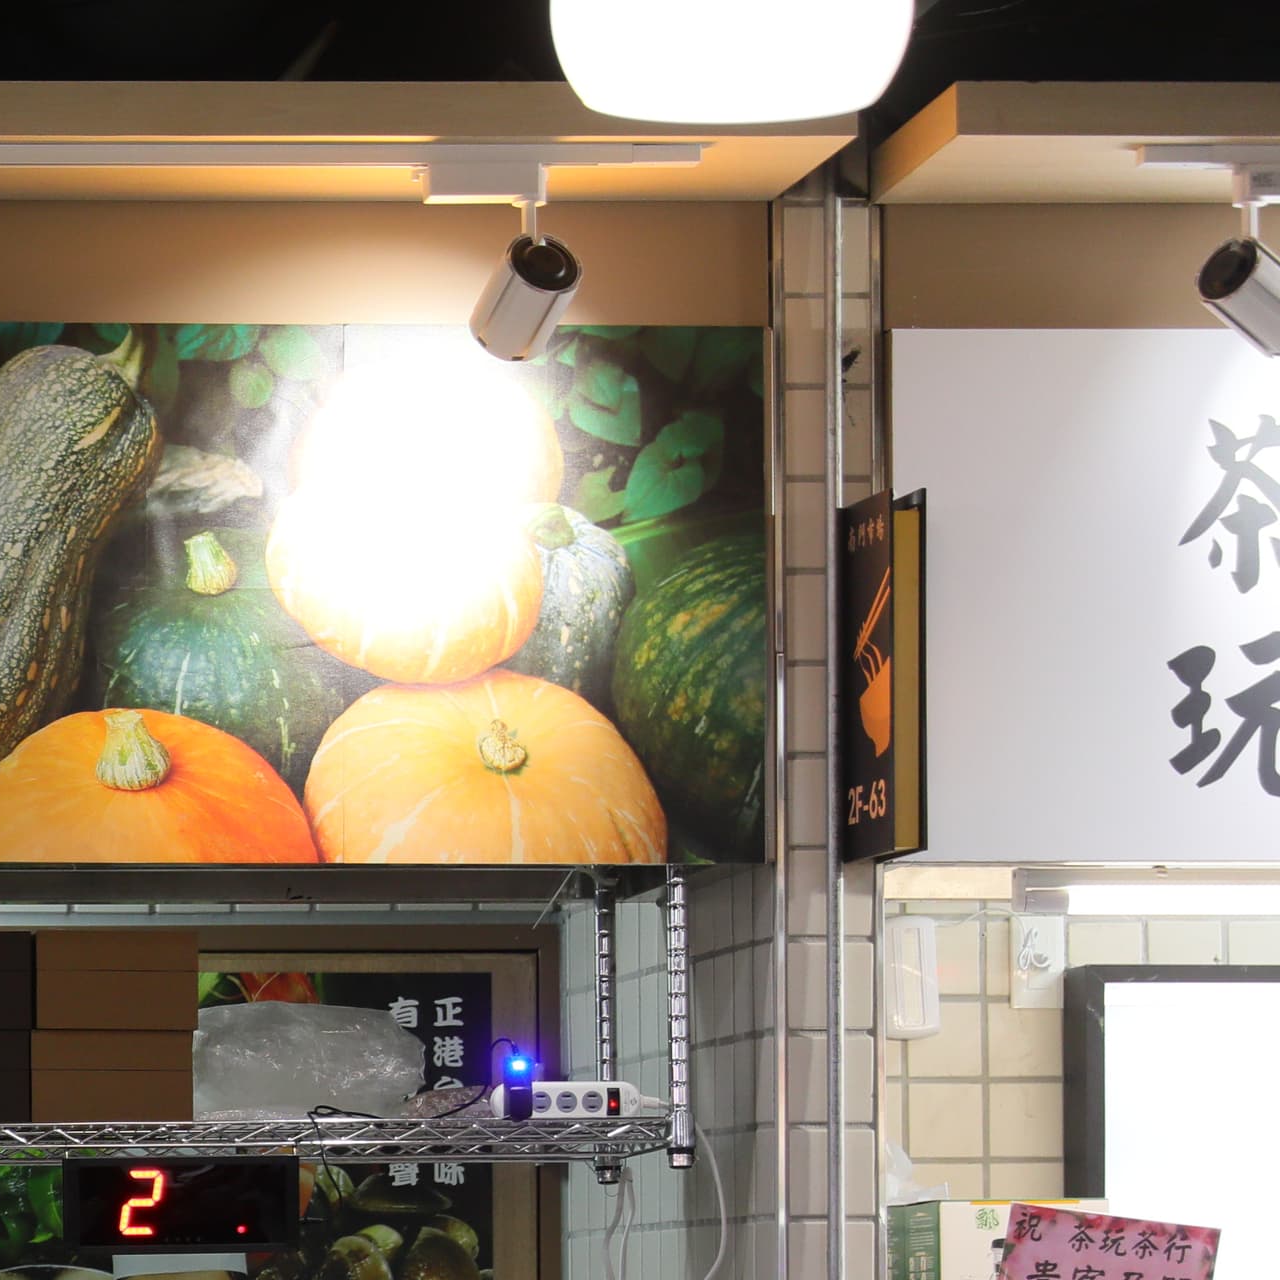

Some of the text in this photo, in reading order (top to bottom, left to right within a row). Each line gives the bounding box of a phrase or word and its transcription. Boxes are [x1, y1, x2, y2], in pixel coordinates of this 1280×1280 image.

[848, 778, 886, 825] 2F-63
[119, 1169, 164, 1236] 2
[1015, 1212, 1193, 1265] 祝 茶玩茶行
